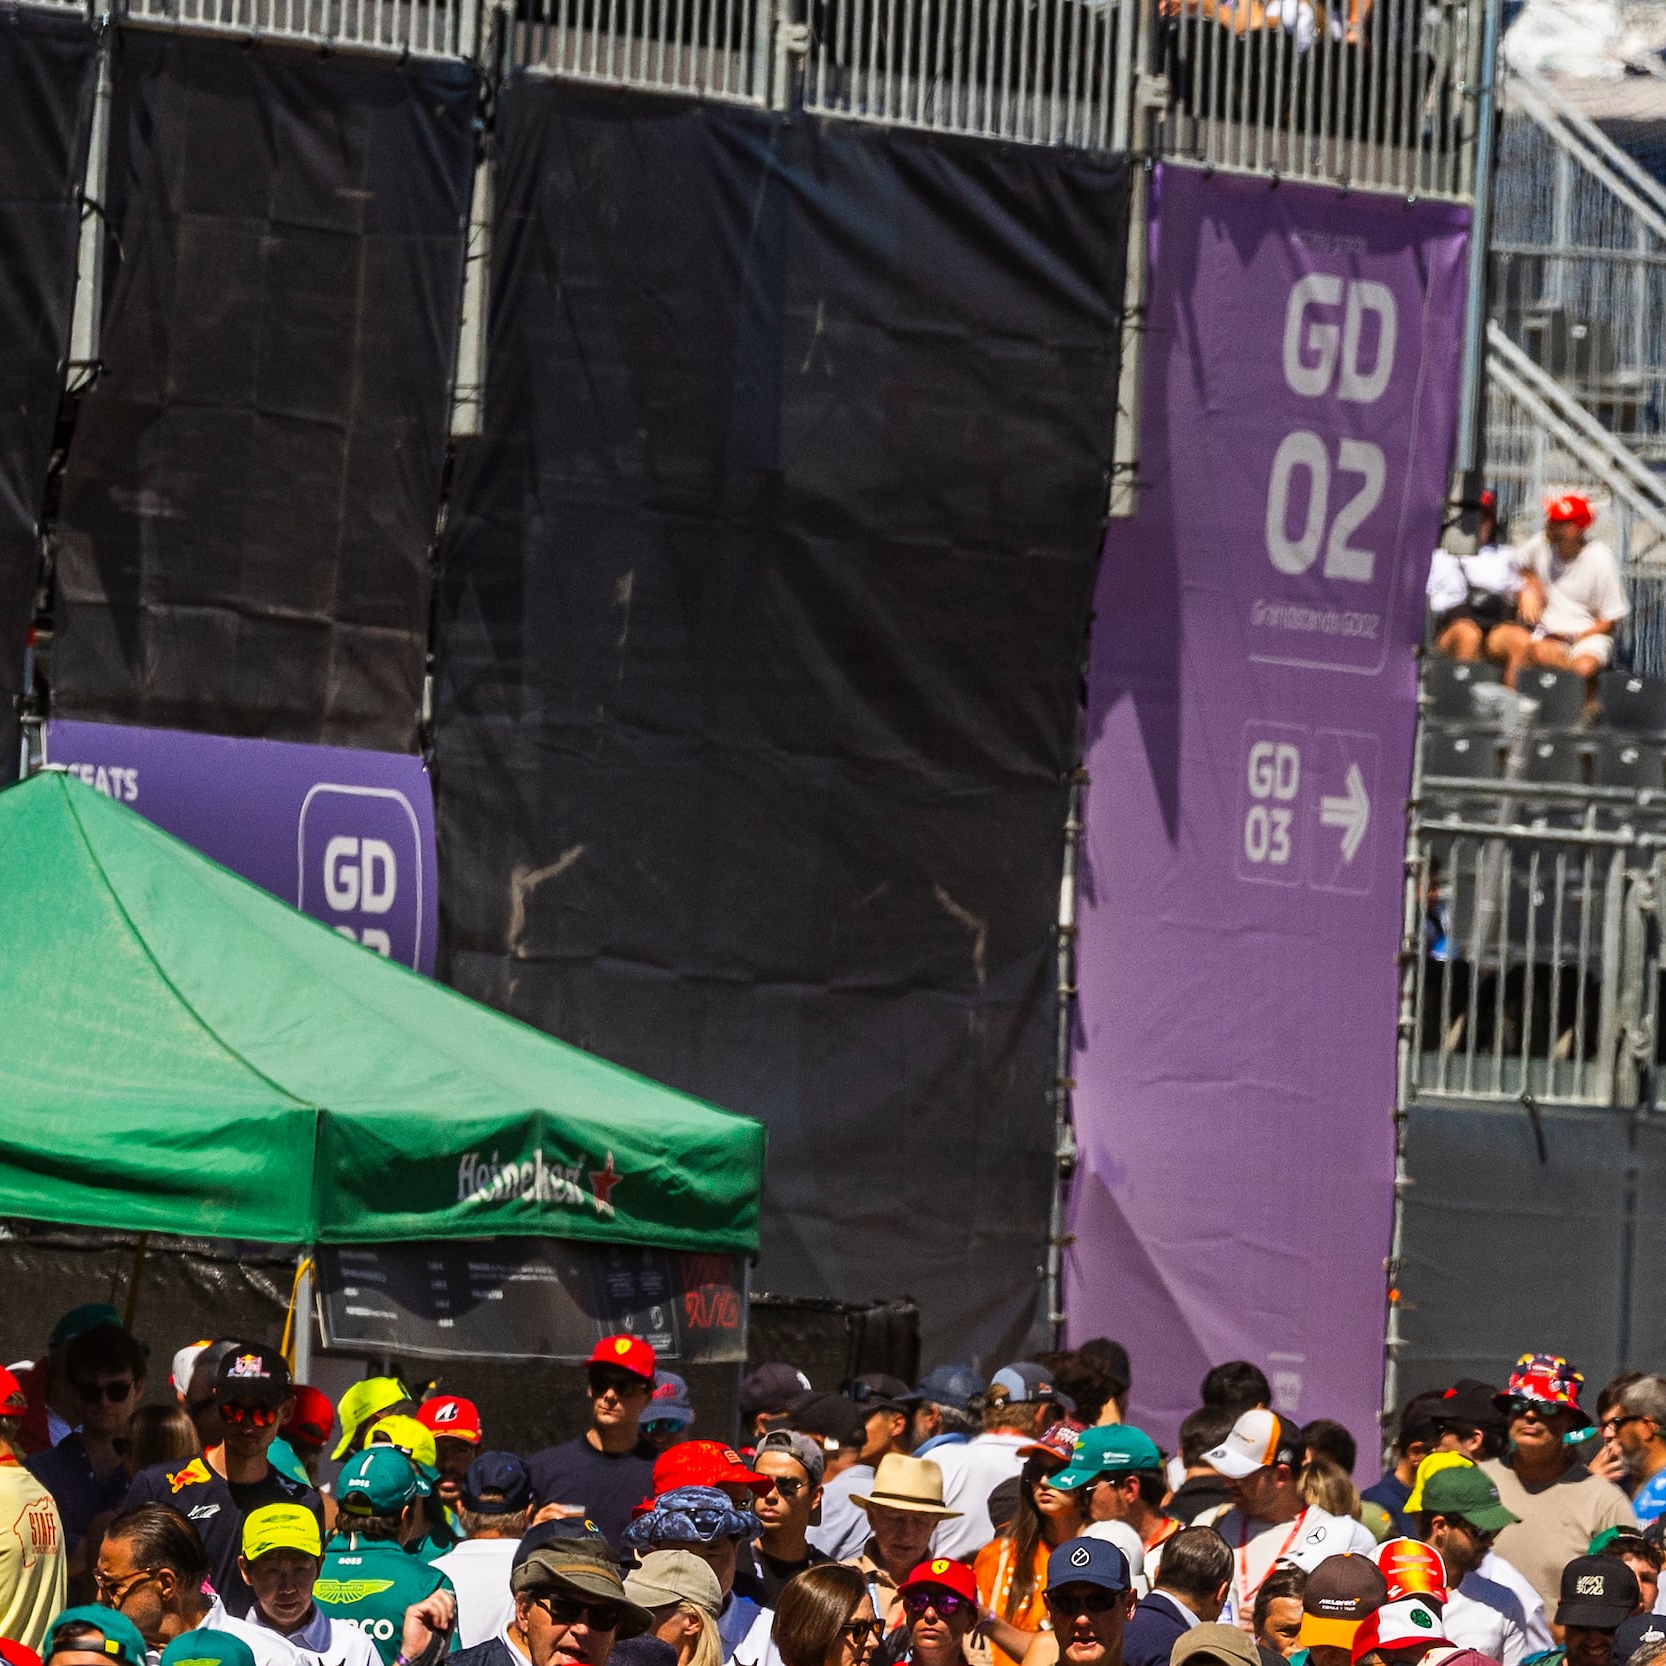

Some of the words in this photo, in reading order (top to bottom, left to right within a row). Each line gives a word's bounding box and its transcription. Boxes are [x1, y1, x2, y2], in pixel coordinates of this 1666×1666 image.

[1282, 273, 1399, 405] GD
[1265, 430, 1386, 584] 02
[1247, 740, 1301, 801] GD
[1244, 805, 1293, 866] 03
[323, 834, 398, 915] GD
[457, 1148, 584, 1203] Heineken
[349, 1478, 370, 1488] BOSS
[28, 1511, 57, 1546] STAFF
[338, 1557, 363, 1566] BOSS
